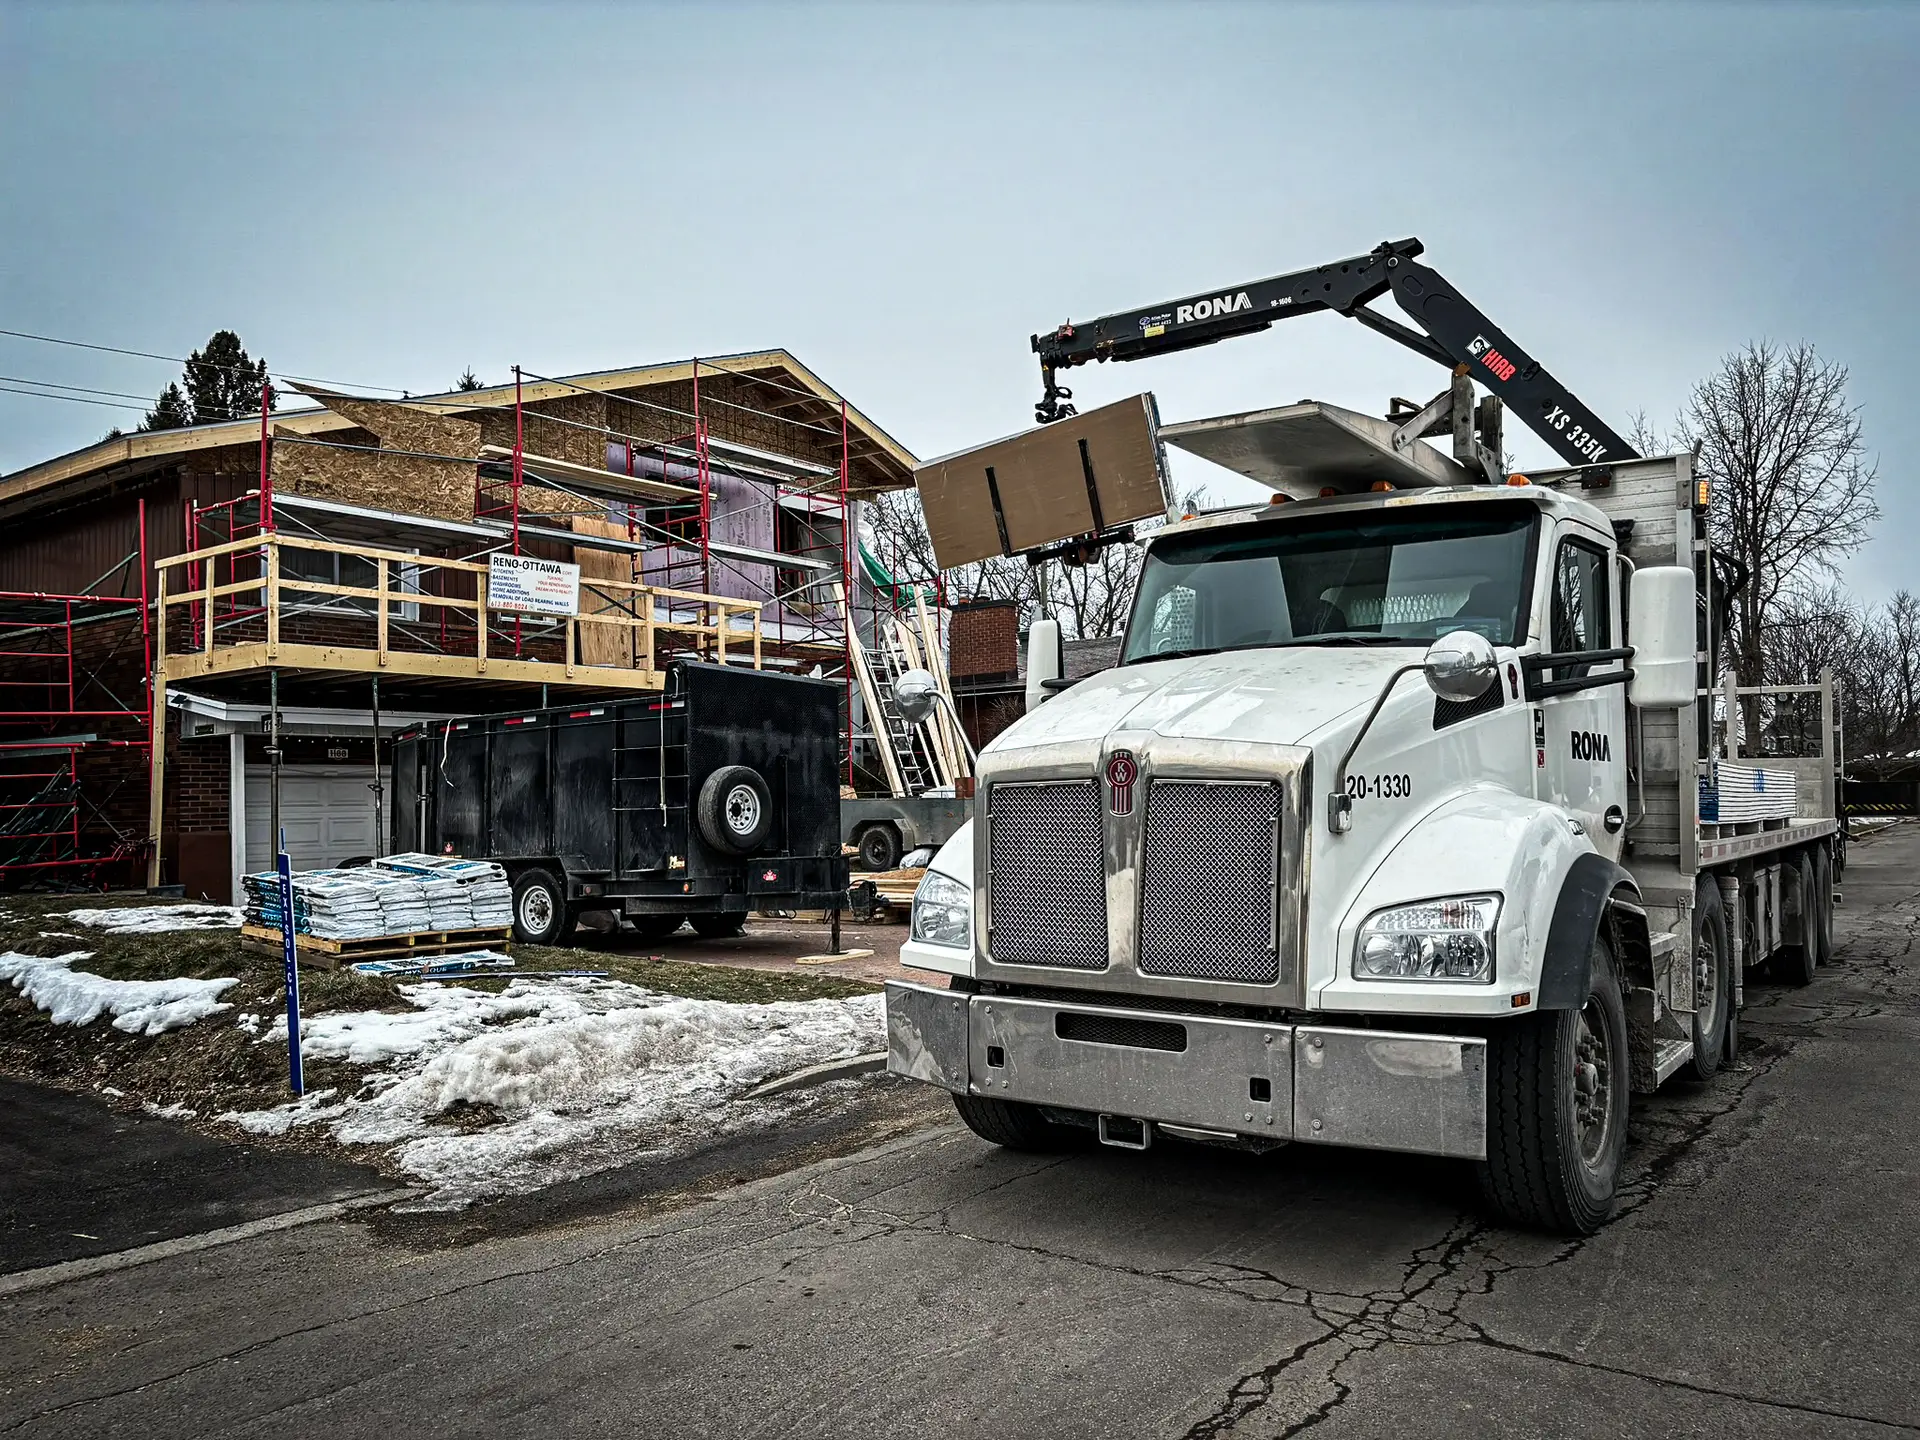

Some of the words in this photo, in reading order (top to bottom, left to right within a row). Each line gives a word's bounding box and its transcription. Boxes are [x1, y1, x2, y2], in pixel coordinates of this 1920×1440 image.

[1176, 291, 1252, 324] RONA
[1481, 348, 1517, 382] HIAB
[1544, 405, 1571, 430] XS
[1566, 425, 1608, 463] 335K
[493, 556, 561, 574] RENO-OTTAWA
[506, 588, 530, 597] ADDITIONS
[1571, 730, 1611, 762] RONA
[1346, 774, 1411, 799] 20-1330
[404, 966, 447, 975] MYSQUE
